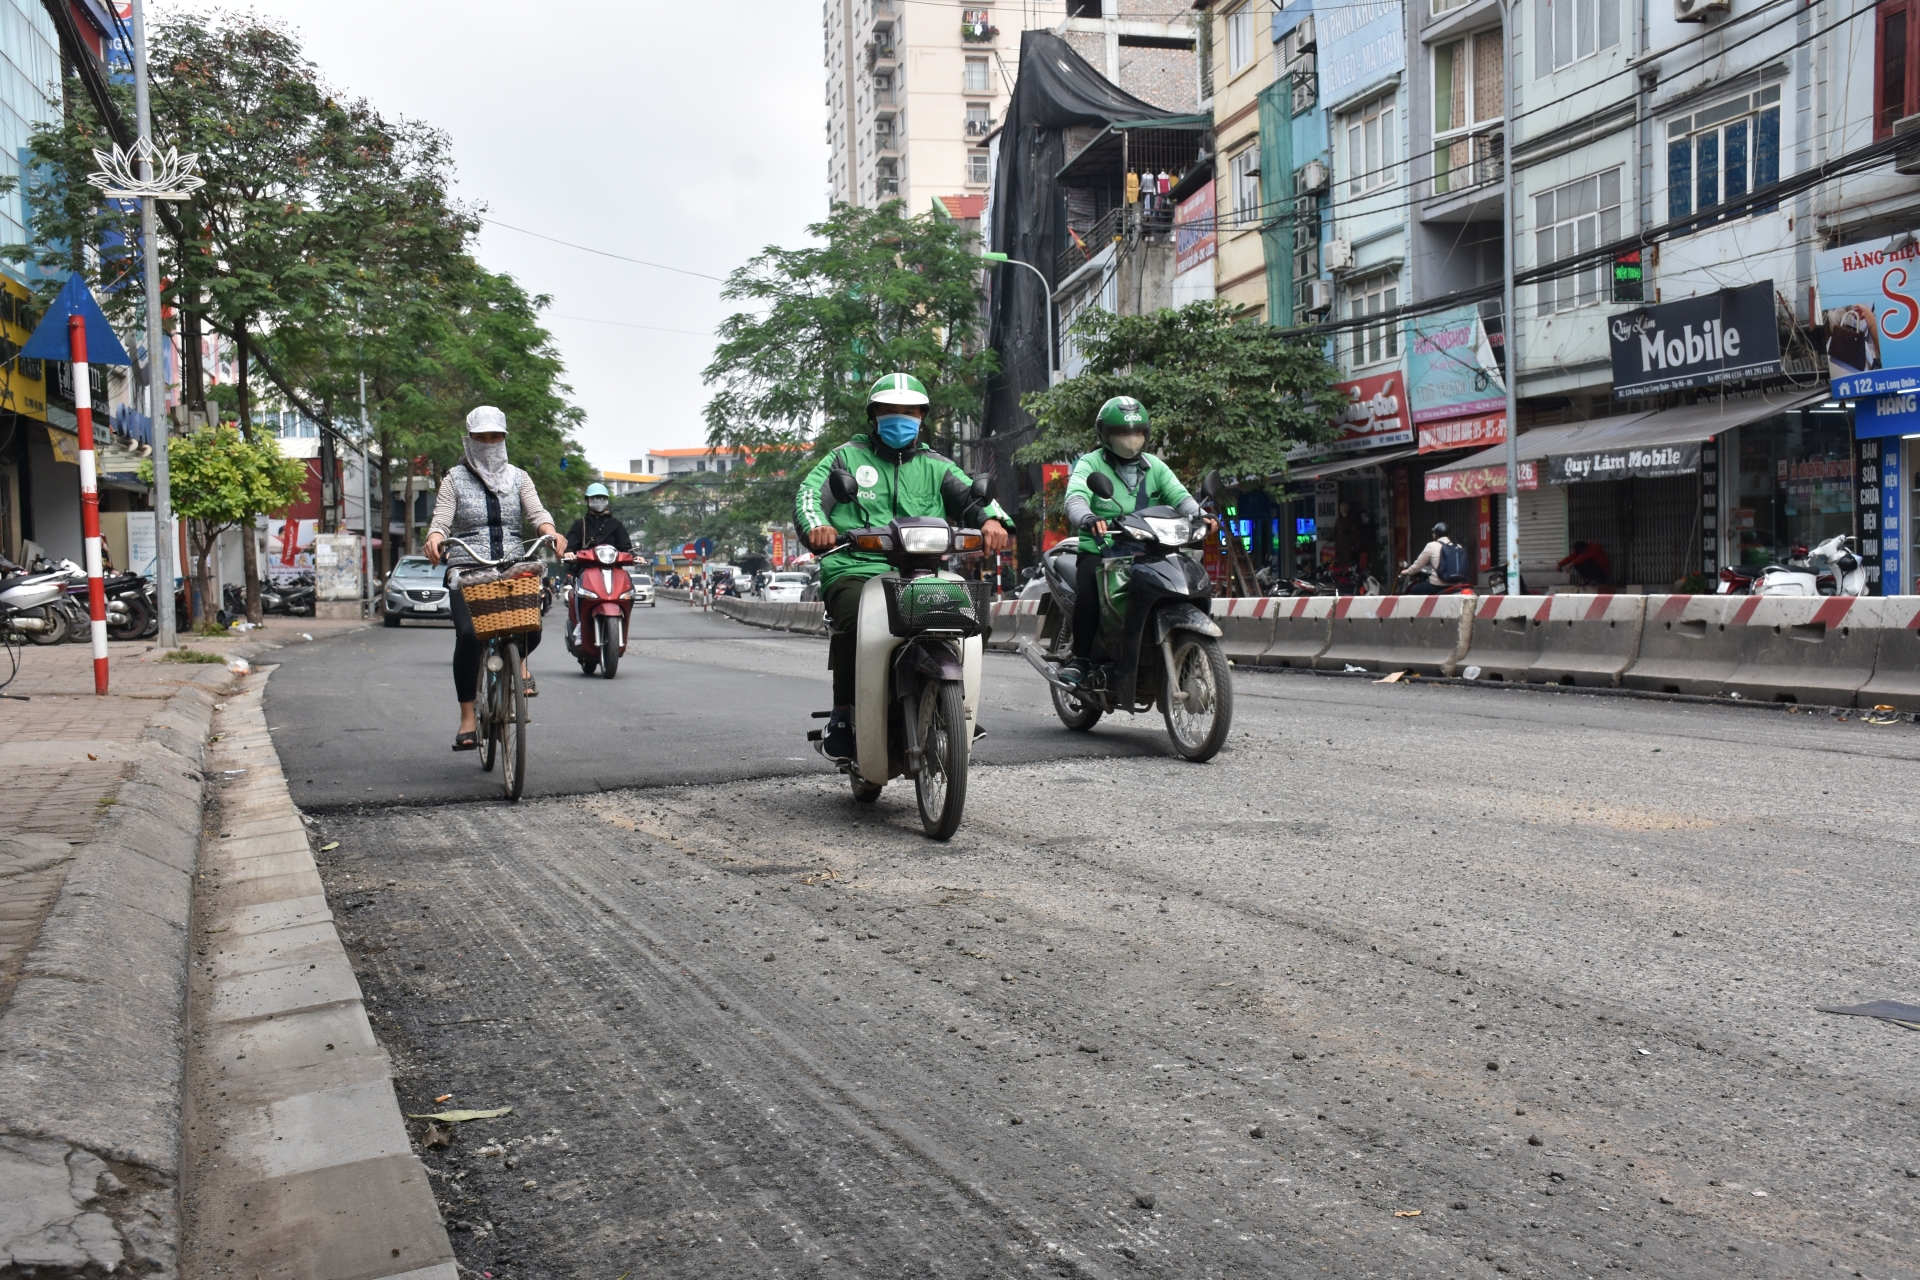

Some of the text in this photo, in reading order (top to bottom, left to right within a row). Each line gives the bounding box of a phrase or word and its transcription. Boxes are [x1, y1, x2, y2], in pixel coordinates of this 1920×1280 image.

[1320, 17, 1330, 50] IN
[1341, 52, 1357, 87] LED
[1362, 41, 1377, 77] MA
[1841, 250, 1884, 273] HÀNG
[1639, 318, 1740, 372] Mobile
[1745, 368, 1753, 377] 091
[1754, 367, 1762, 376] 291
[1854, 378, 1873, 394] 122
[1886, 380, 1900, 390] Long
[1876, 394, 1917, 416] HÀNG
[1124, 413, 1142, 421] Grab
[1593, 454, 1625, 471] Lâm
[1628, 447, 1681, 468] Mobile
[1886, 453, 1897, 469] PHỤ
[1862, 461, 1877, 483] SỬA
[1885, 472, 1898, 490] KIỆN
[857, 489, 876, 500] rab
[1860, 484, 1879, 505] CHỮA
[1888, 495, 1894, 509] &
[1095, 501, 1112, 510] Grab
[1863, 510, 1877, 534] ĐIỆN
[1885, 514, 1898, 530] KÍNH
[1862, 539, 1878, 560] THOẠI
[1883, 535, 1898, 551] HÀNG
[1885, 557, 1897, 575] HIỆU
[916, 593, 950, 604] Grab
